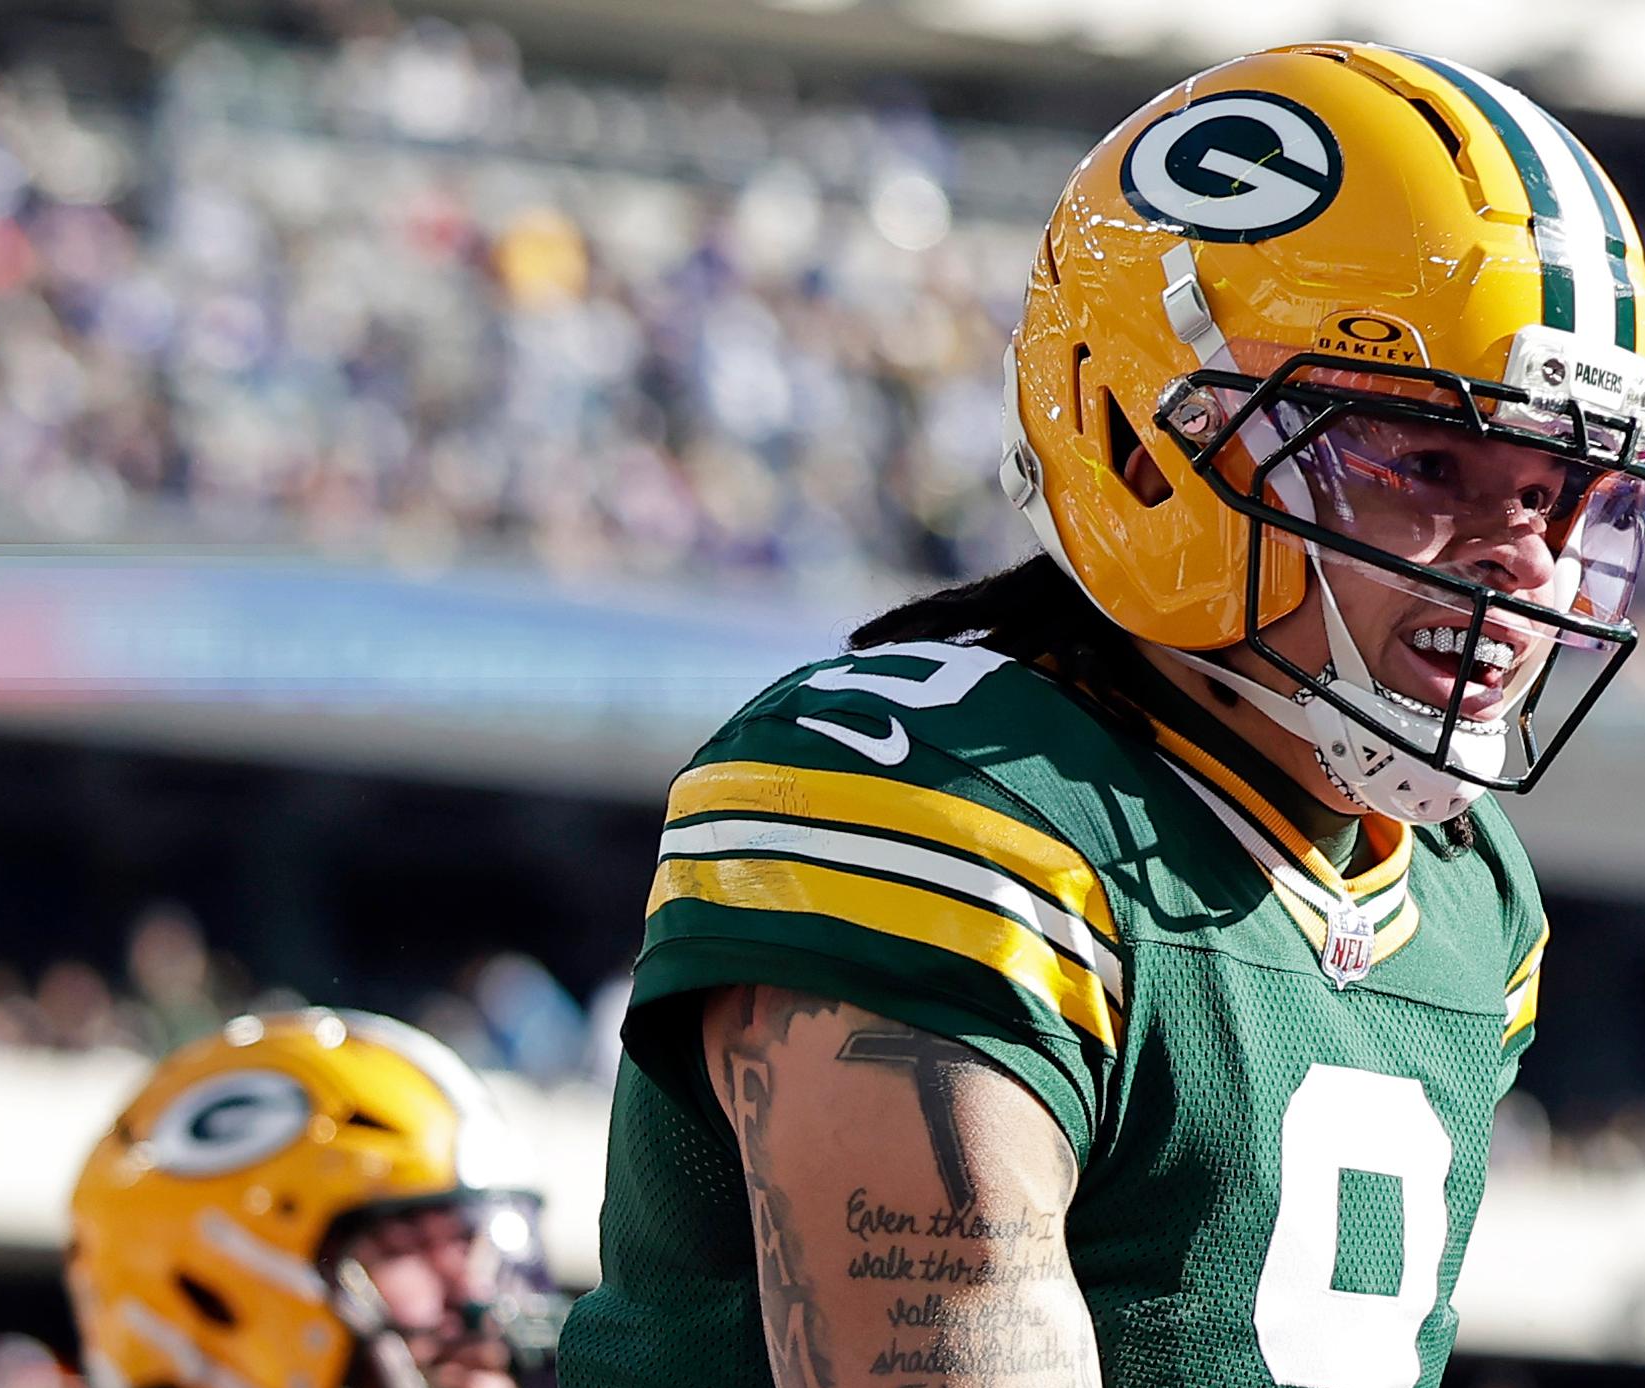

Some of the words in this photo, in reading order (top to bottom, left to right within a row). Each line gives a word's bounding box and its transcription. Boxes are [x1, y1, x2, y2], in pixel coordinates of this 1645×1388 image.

[1131, 98, 1329, 231] G
[1319, 338, 1415, 362] OAKLEY
[1575, 362, 1623, 394] PACKERS
[1330, 937, 1364, 972] NFL
[846, 1187, 919, 1241] Even
[847, 1245, 917, 1280] walk
